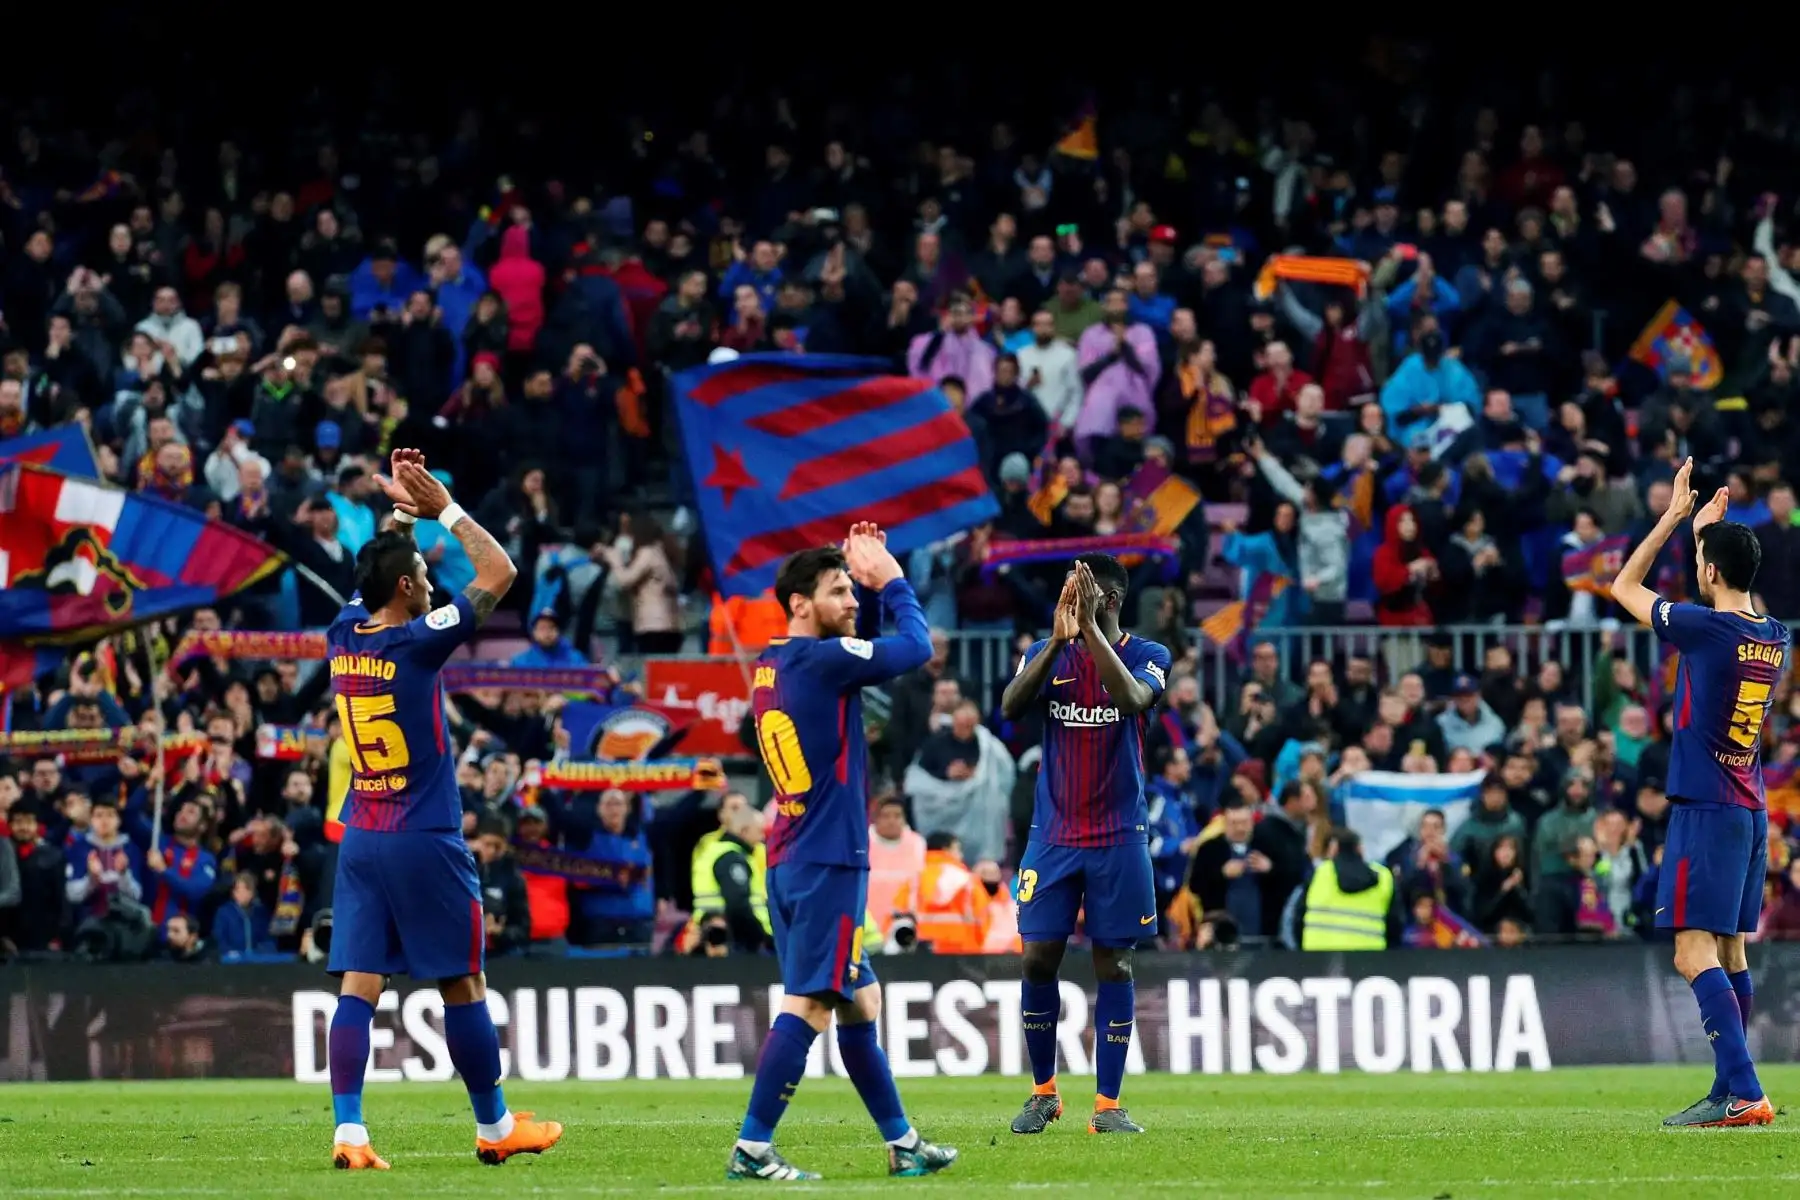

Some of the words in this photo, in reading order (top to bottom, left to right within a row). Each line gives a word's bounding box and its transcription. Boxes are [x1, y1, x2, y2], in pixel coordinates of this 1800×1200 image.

[330, 655, 396, 680] PAULINHO
[1737, 643, 1783, 668] SERGIO
[335, 693, 410, 773] 15
[1728, 680, 1772, 749] 5
[755, 709, 813, 796] 0
[354, 775, 388, 792] unicef
[1017, 868, 1038, 903] 3
[1167, 974, 1552, 1075] HISTORIA
